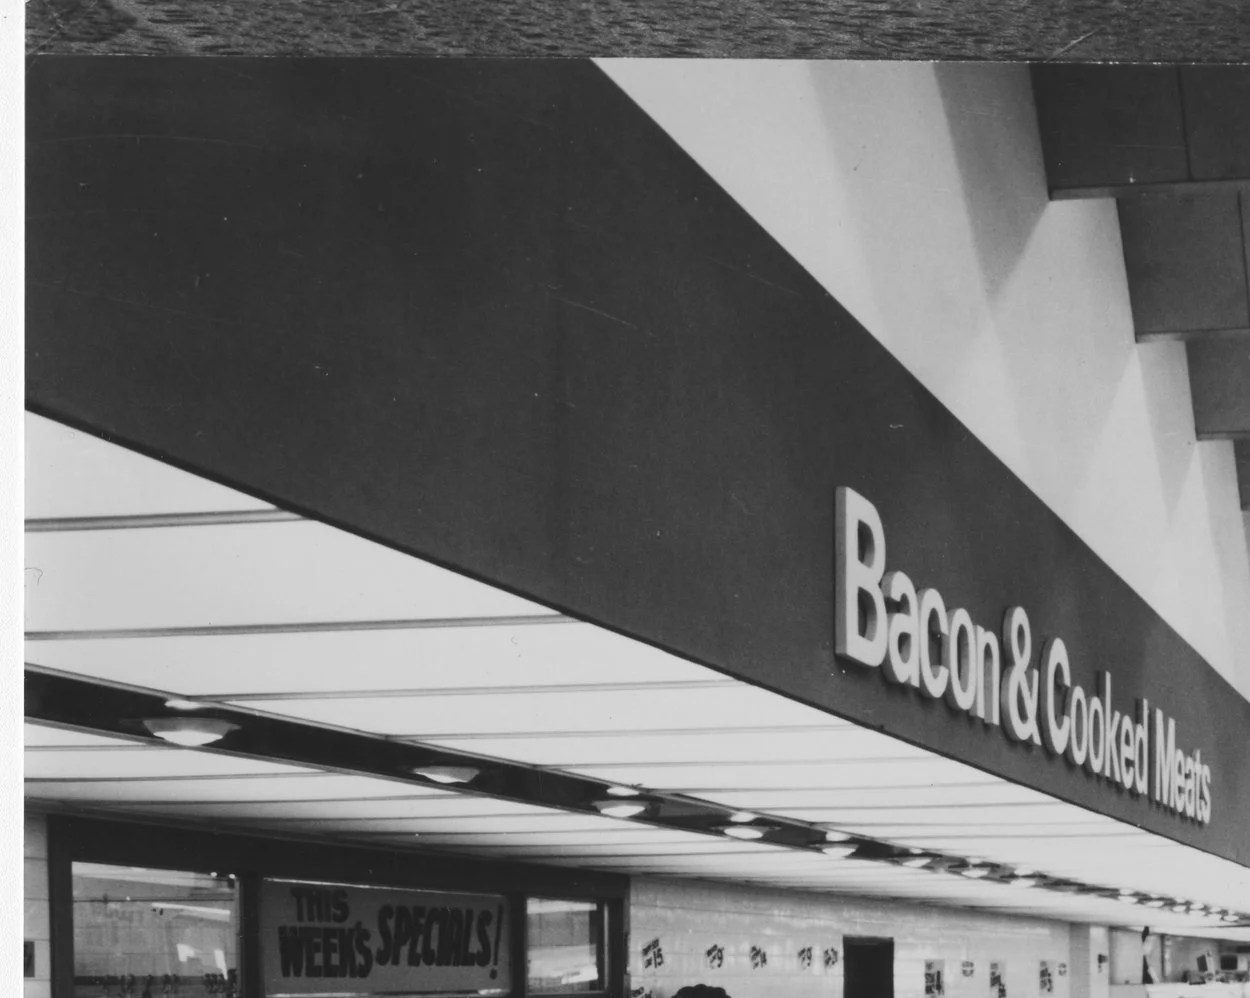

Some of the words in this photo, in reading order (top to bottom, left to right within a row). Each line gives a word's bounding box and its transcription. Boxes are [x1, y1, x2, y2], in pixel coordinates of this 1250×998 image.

[835, 486, 1000, 725] Bacon
[1001, 606, 1042, 746] &
[1040, 637, 1149, 796] Cooked
[1154, 707, 1212, 825] Meats
[290, 887, 349, 923] THIS
